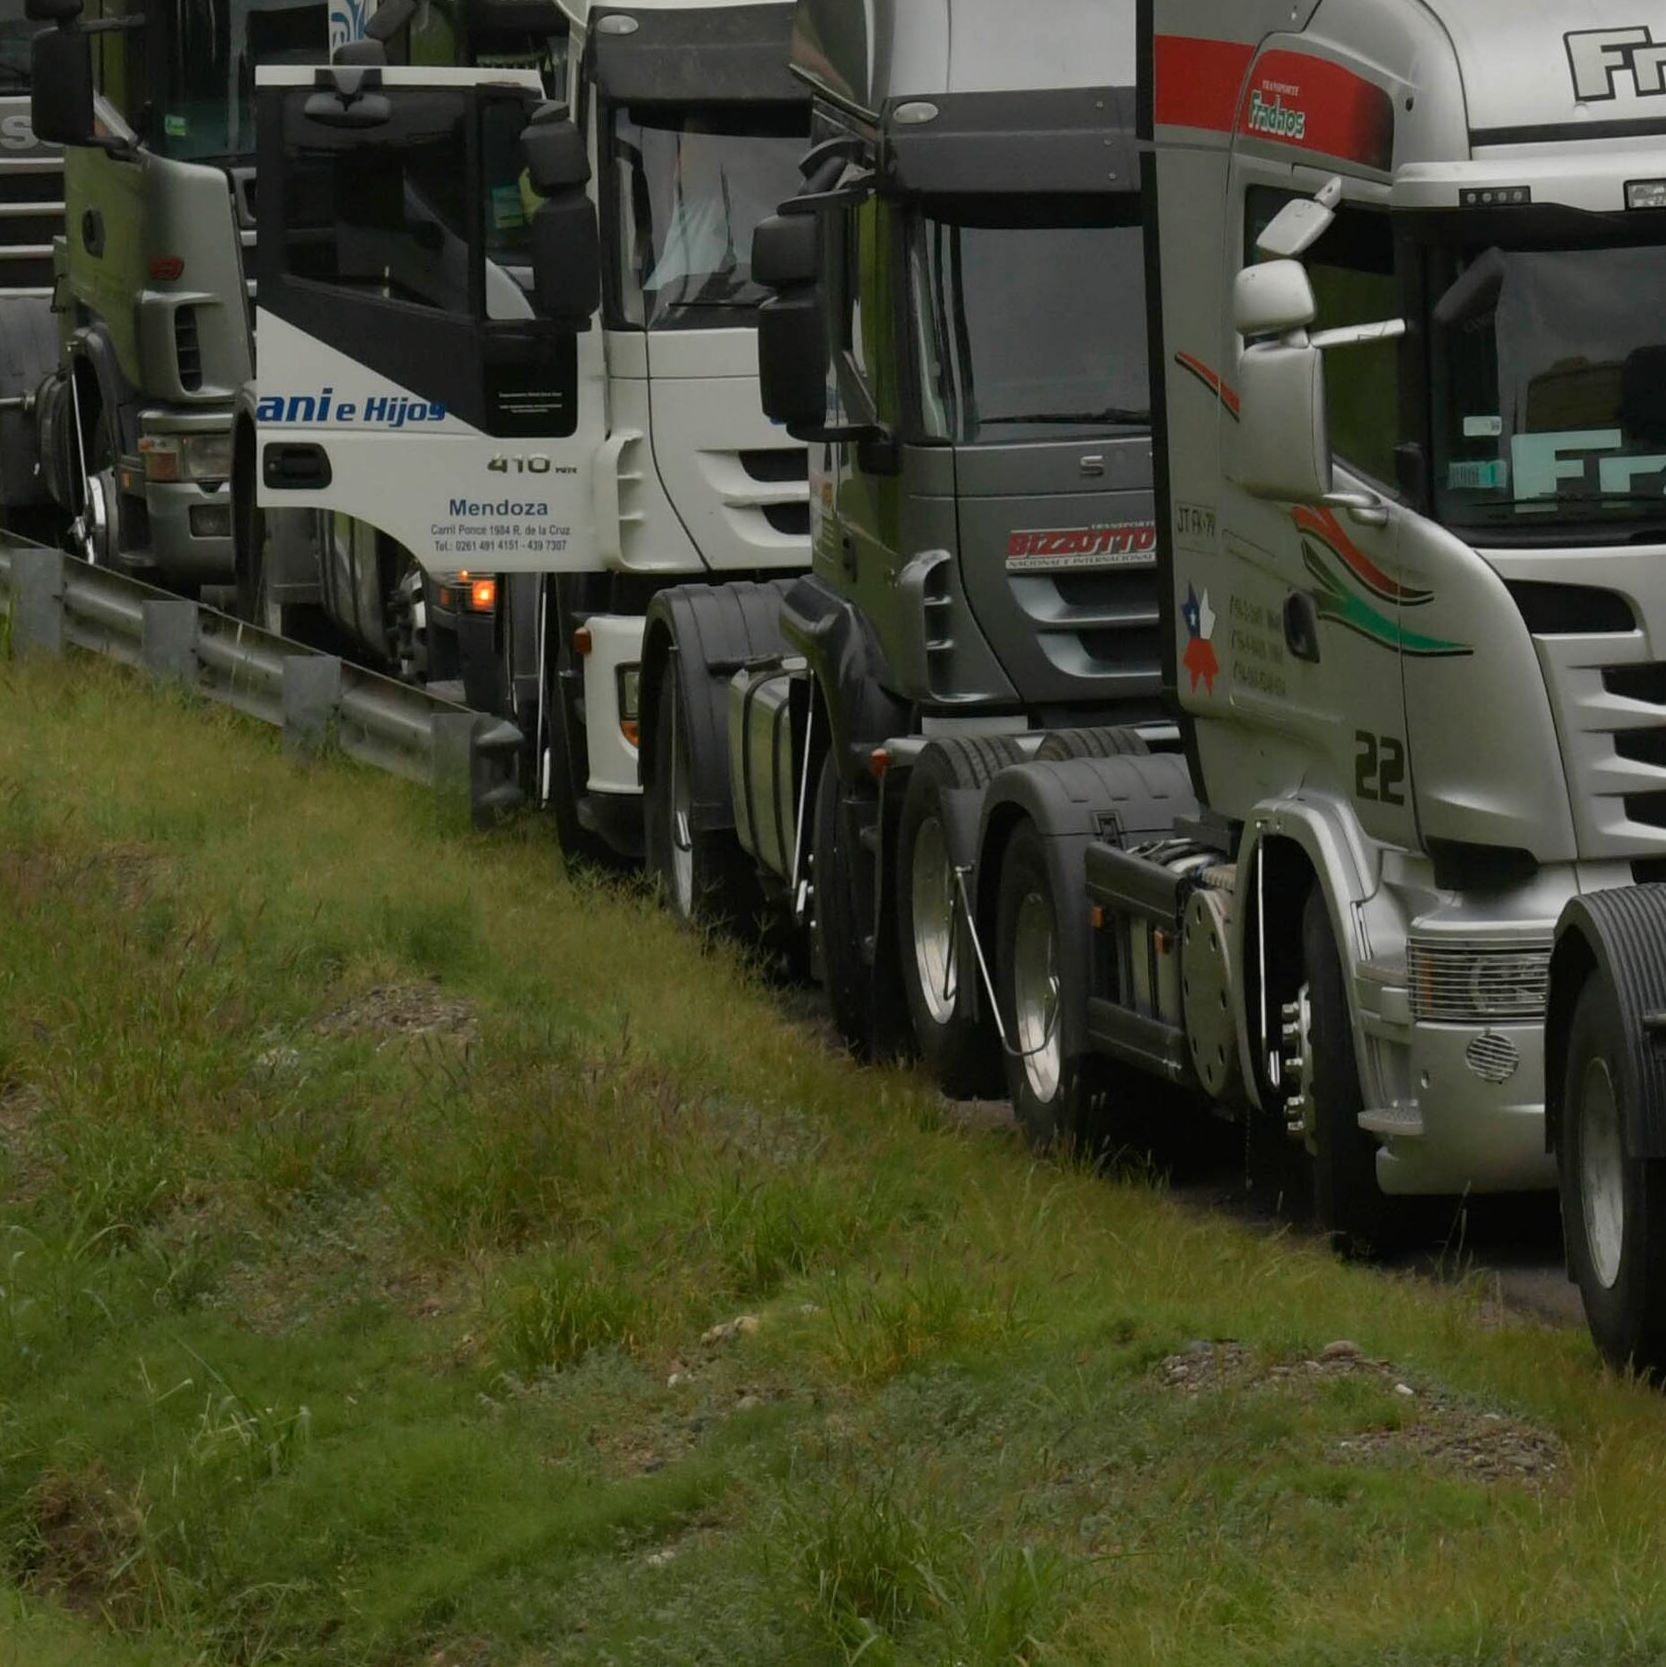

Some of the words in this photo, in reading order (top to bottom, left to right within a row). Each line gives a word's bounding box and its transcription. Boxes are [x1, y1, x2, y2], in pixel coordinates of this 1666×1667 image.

[336, 403, 356, 422] e
[488, 453, 550, 473] 410
[449, 499, 548, 517] Mendoza
[459, 524, 487, 535] Ponce
[525, 524, 536, 535] de
[539, 524, 546, 535] la
[549, 524, 570, 535] Cruz
[455, 540, 476, 551] 0261
[479, 540, 494, 551] 491
[498, 540, 518, 551] 4151
[527, 540, 543, 551] 439
[546, 540, 566, 551] 7307
[1355, 731, 1405, 805] 22
